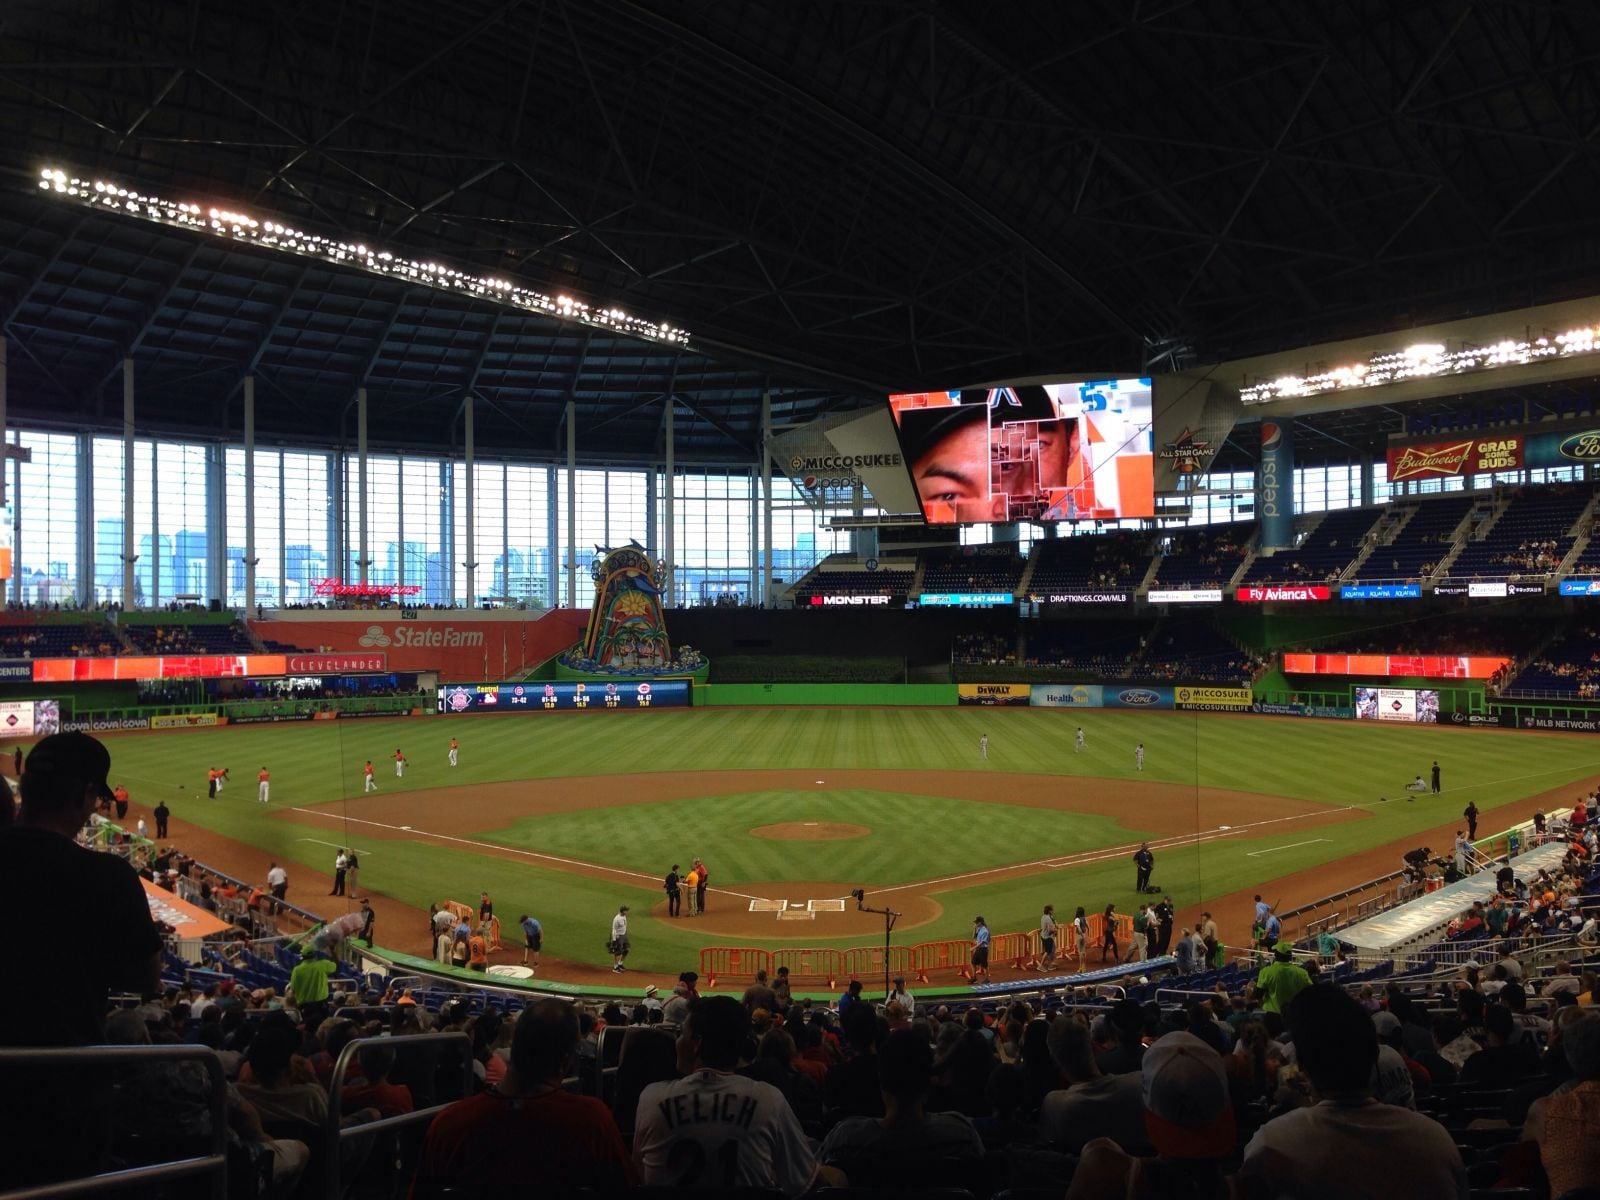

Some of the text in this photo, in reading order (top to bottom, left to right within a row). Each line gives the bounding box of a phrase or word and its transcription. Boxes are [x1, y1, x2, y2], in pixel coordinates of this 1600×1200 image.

[1192, 448, 1214, 456] GAME
[1478, 440, 1517, 453] GRAB
[805, 454, 900, 469] MICCOSUKEE
[1397, 454, 1469, 470] Budweiser
[1478, 457, 1517, 470] BUDS
[821, 475, 860, 491] pepsi
[1262, 452, 1280, 518] pepsi
[823, 595, 888, 605] MONSTER
[1050, 594, 1126, 603] DRAFTKINGS.COM/MLB
[1250, 588, 1307, 600] Fly Avianca
[290, 658, 381, 671] CLEVELANDER
[1126, 691, 1152, 703] Ford
[1193, 689, 1249, 699] MICCOSUKEE
[63, 718, 147, 732] GOYA GOYA GOYA
[1464, 715, 1499, 723] LEXUS
[1536, 718, 1553, 727] MLB
[1555, 720, 1596, 729] NETWORK
